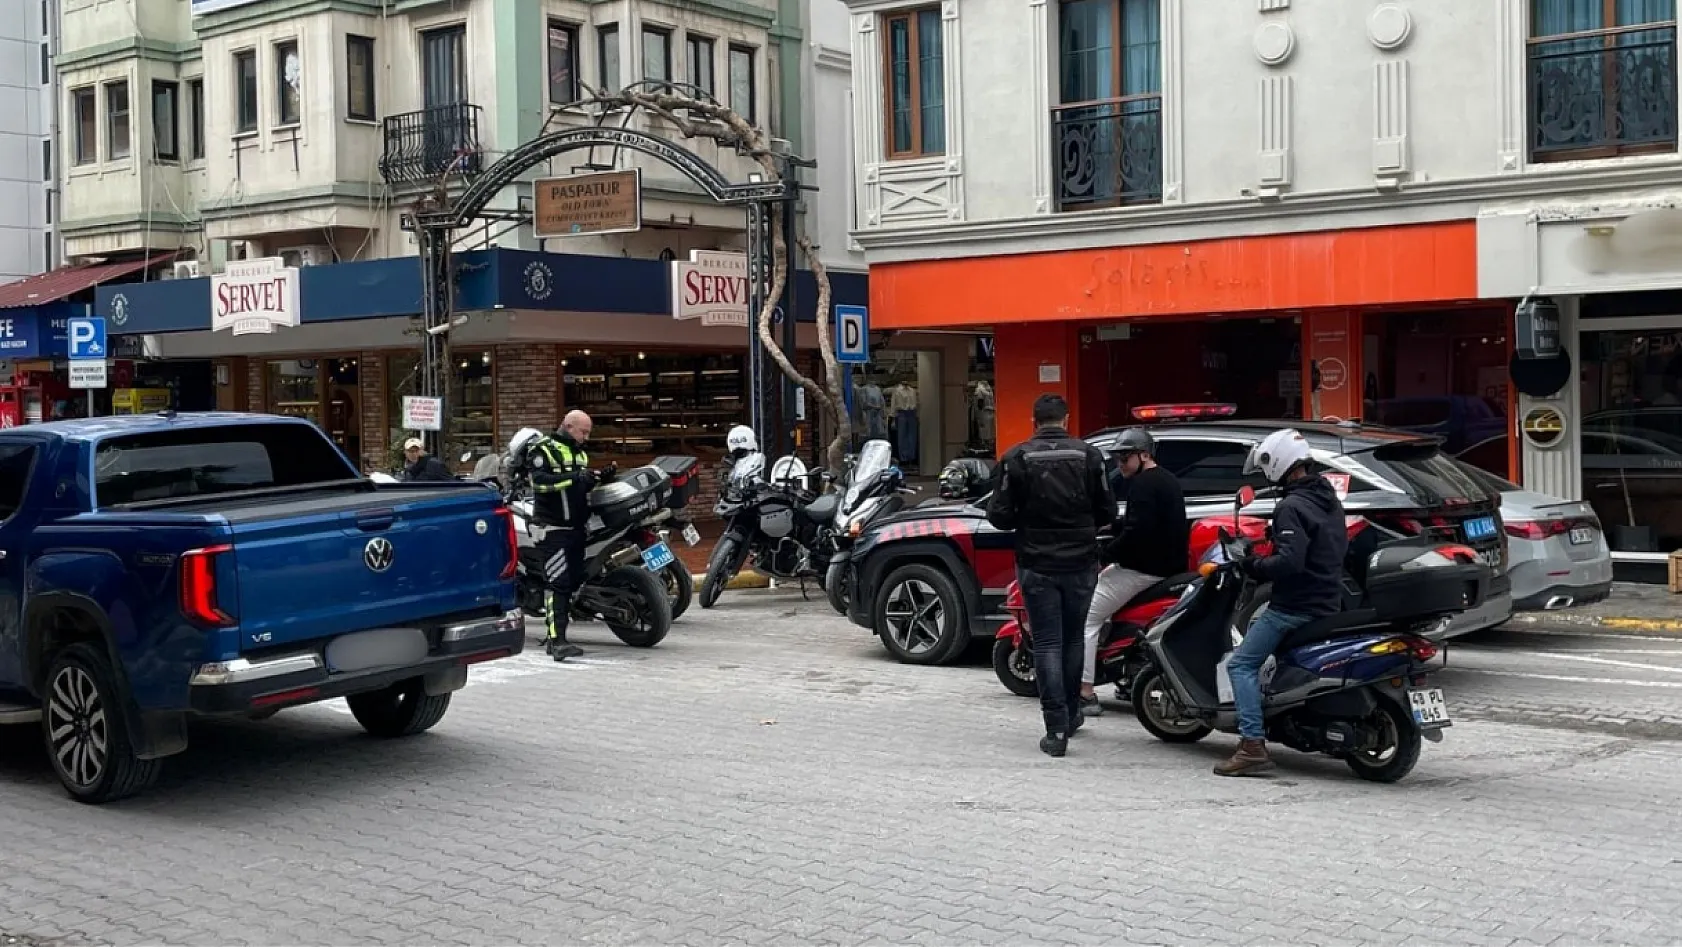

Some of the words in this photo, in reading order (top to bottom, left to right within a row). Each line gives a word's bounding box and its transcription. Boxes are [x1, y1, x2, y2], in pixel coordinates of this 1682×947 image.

[551, 181, 620, 200] PASPATUR
[217, 277, 287, 318] SERVET
[685, 269, 748, 306] SERV
[71, 321, 95, 354] P
[845, 319, 859, 349] D
[251, 632, 272, 643] V6
